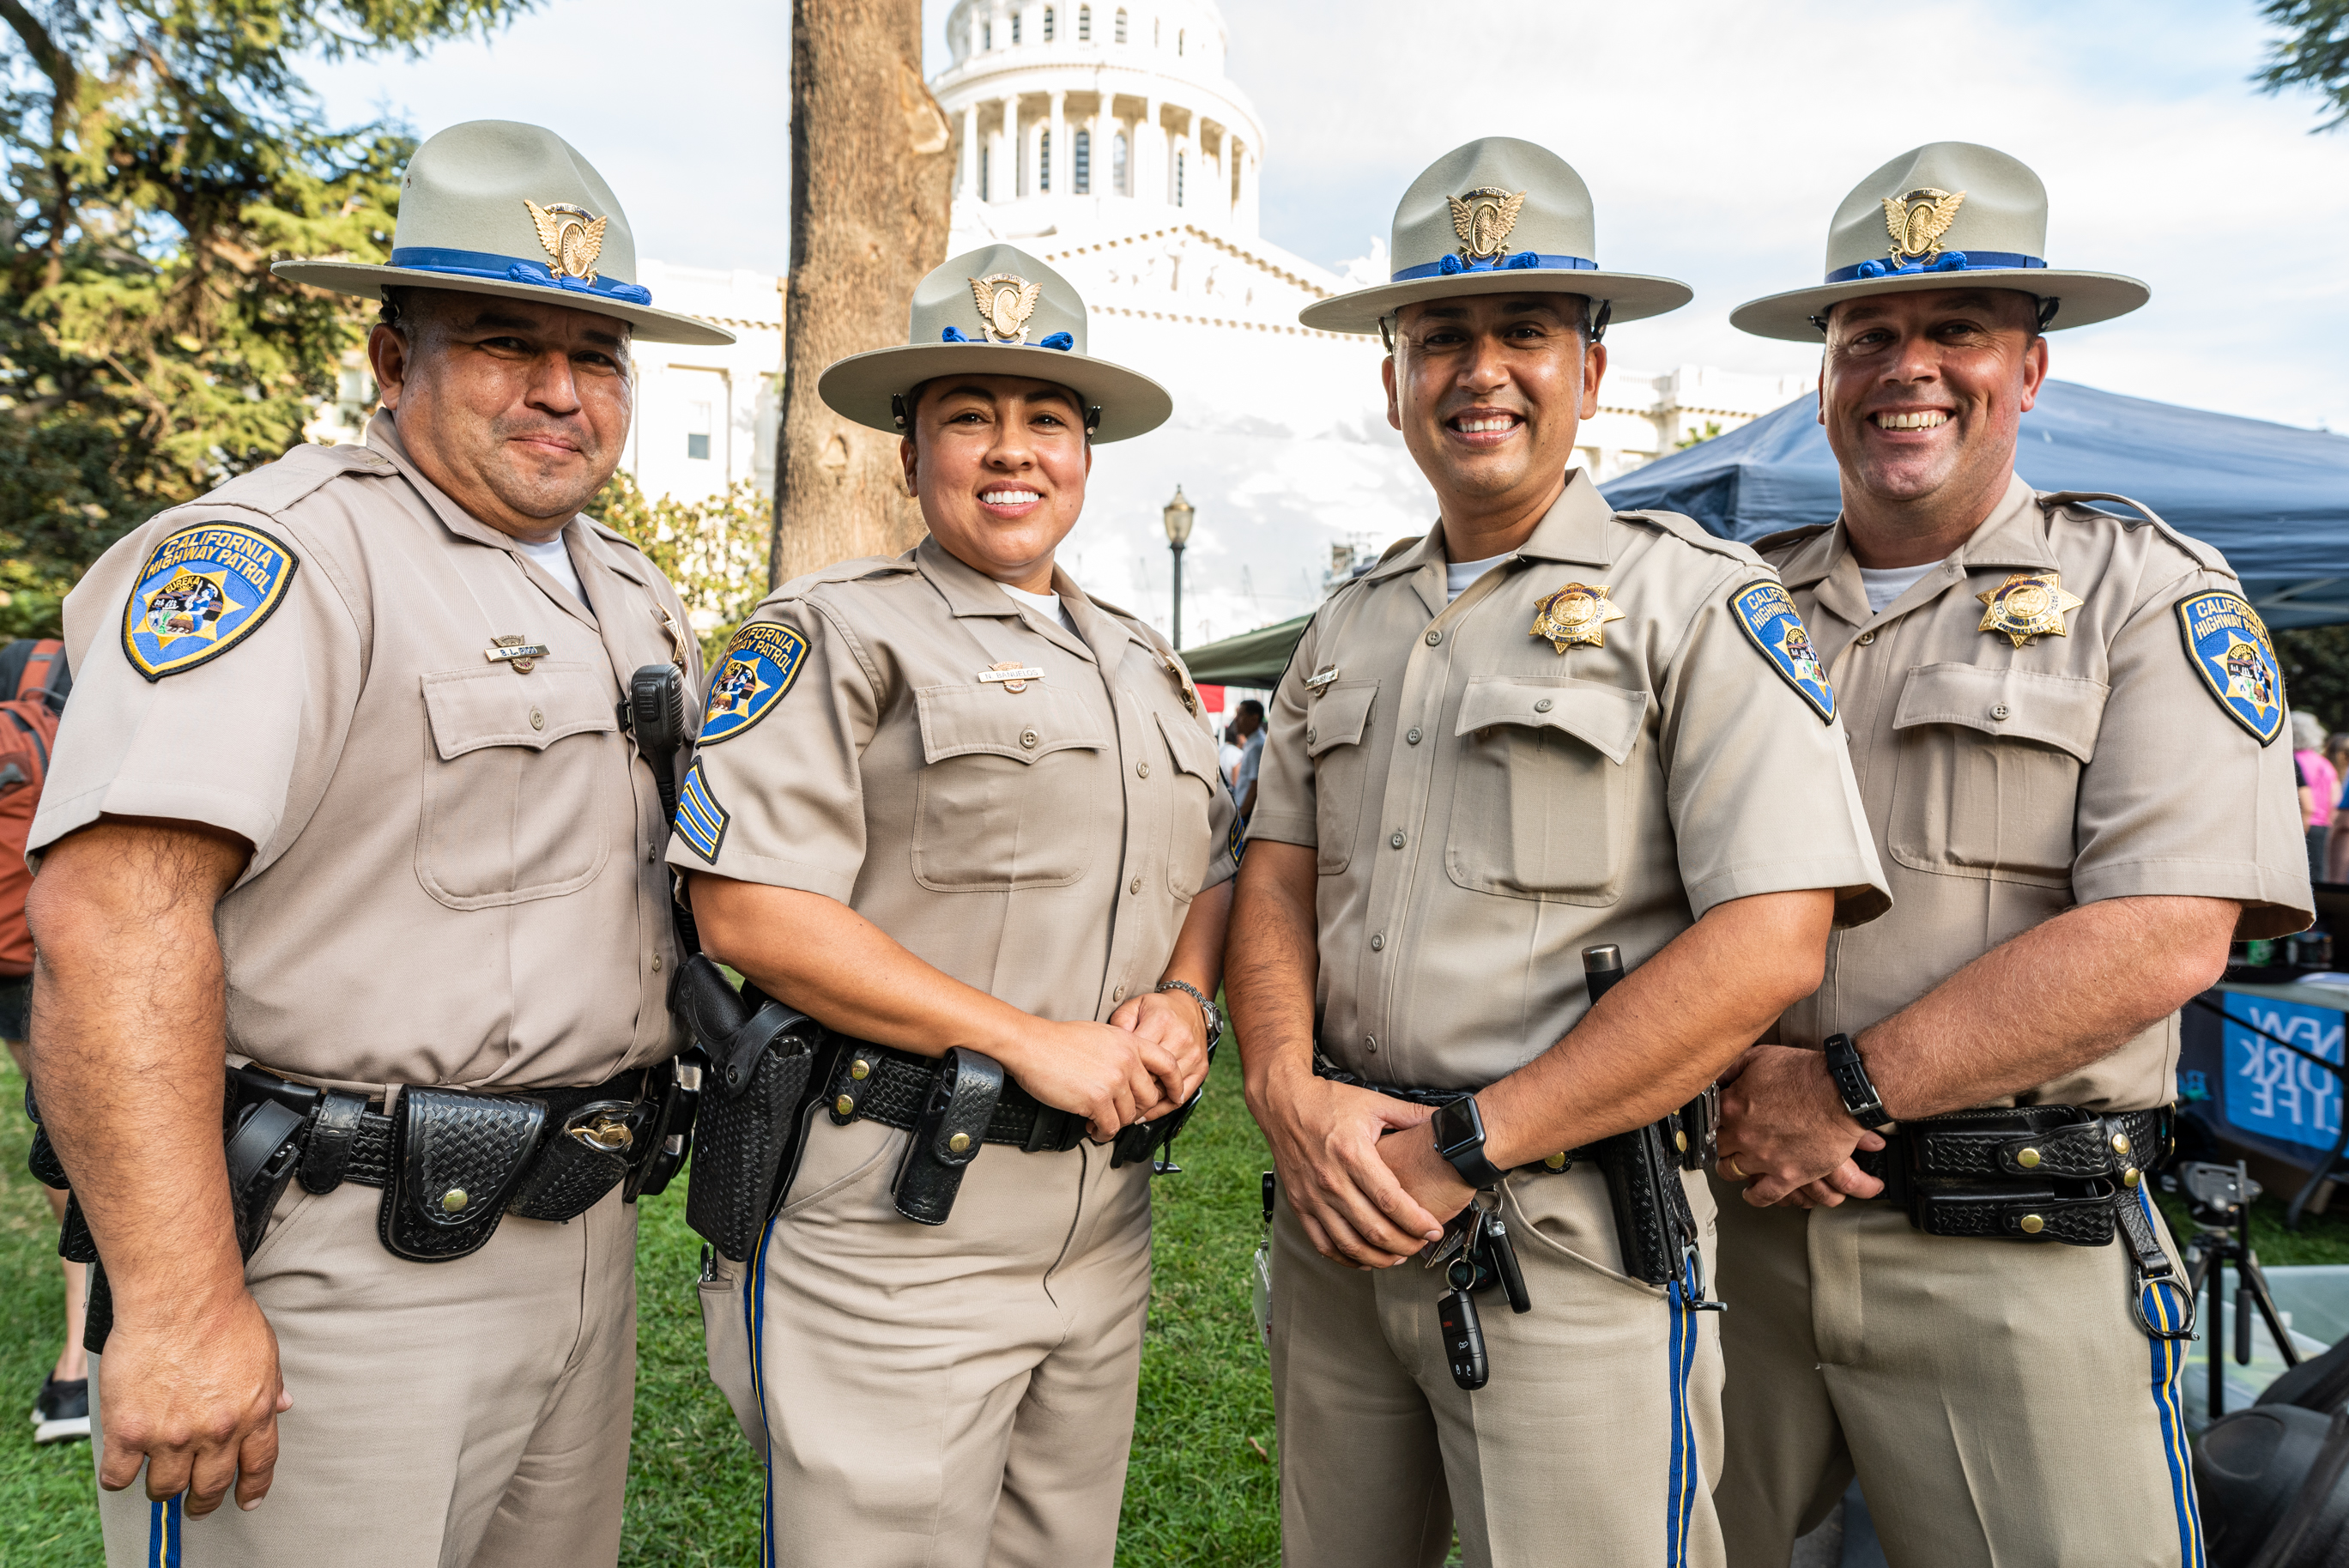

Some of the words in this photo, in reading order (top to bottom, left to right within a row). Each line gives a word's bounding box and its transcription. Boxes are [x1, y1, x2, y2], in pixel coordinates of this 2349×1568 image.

[1465, 188, 1507, 200] CALIFORNIA
[1901, 189, 1945, 202] CALIFORNIA
[549, 205, 593, 222] CALIFORNIA
[986, 273, 1026, 286] CALIFORNIA
[162, 531, 274, 569] CALIFORNIA
[146, 546, 220, 580] HIGHWAY
[216, 550, 271, 595] PATROL
[165, 576, 201, 594] EUREKA
[1573, 587, 1601, 602] HIGHWAY
[1587, 604, 1605, 626] PATROL
[1747, 587, 1796, 610] CALIFO
[2043, 595, 2059, 618] PATROL
[1750, 601, 1791, 631] HIGHWAY
[2007, 616, 2037, 627] 20517
[2195, 598, 2266, 637] CALIFORNIA
[1544, 629, 1583, 643] OFFICER
[1998, 622, 2045, 634] OFFICER
[2195, 613, 2243, 640] HIGHWAY
[2243, 617, 2274, 662] PATROL
[754, 641, 791, 674] PATROL
[2230, 645, 2252, 660] EUREKA
[996, 669, 1038, 679] BANUELOS
